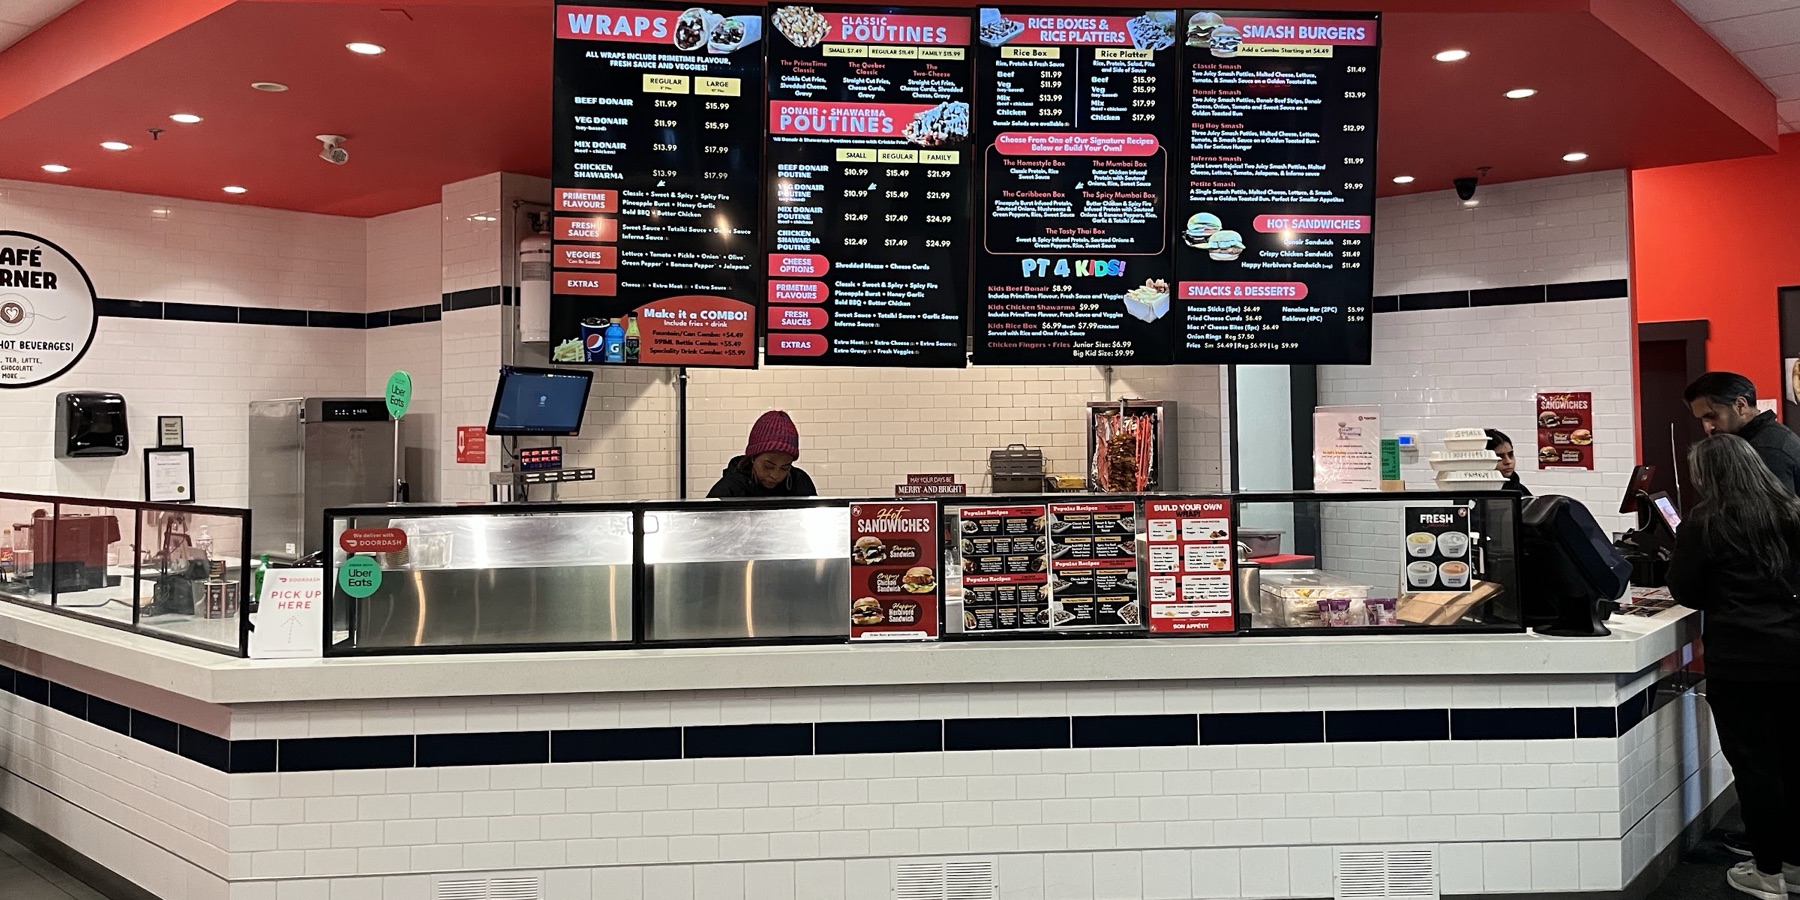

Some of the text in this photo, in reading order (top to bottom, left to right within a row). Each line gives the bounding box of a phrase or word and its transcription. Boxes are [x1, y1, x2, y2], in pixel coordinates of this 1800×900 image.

[842, 16, 887, 25] CLASSIC
[1028, 18, 1109, 30] RICE BOXES &
[568, 14, 668, 38] WRAPS
[842, 26, 946, 42] POUTINES
[1041, 32, 1125, 42] RICE PLATTERS
[1242, 25, 1365, 40] SMASH BURGERS
[657, 54, 695, 62] PRIMETIME
[1133, 76, 1156, 84] $15.99
[1039, 94, 1062, 102] $13.99
[599, 98, 633, 106] DONAIR
[655, 100, 677, 108] $11.99
[705, 102, 729, 110] $15.99
[781, 107, 885, 117] DONAIR SHAWARMA
[594, 117, 628, 125] DONAIR
[654, 119, 676, 127] $11.99
[705, 122, 729, 130] $15.99
[780, 116, 893, 133] POUTINES
[592, 142, 626, 150] DONAIR
[653, 144, 677, 152] $13.99
[704, 146, 728, 154] $17.99
[574, 163, 612, 171] CHICKEN
[574, 171, 623, 180] SHAWARMA
[704, 172, 728, 180] $17.99
[844, 168, 868, 176] $10.99
[927, 170, 950, 178] $21.99
[563, 193, 605, 201] PRIMETIME
[563, 201, 605, 209] FLAVOURS
[926, 215, 951, 223] $24.99
[1267, 220, 1360, 229] HOT SANDWICHES
[568, 229, 599, 237] SAUCES
[0, 246, 42, 267] AFÉ
[566, 251, 601, 259] VEGGIES
[1022, 259, 1126, 277] PT 4 KIDS!
[0, 269, 57, 290] RNER
[568, 280, 598, 288] EXTRAS
[1188, 286, 1296, 296] SNACKS & DESSERTS
[644, 309, 675, 319] Make
[678, 310, 686, 319] it
[700, 310, 747, 321] COMBO!
[392, 384, 405, 397] Uber
[390, 395, 404, 408] Eats
[1541, 401, 1588, 410] SANDWICHES
[877, 506, 910, 520] Hot
[1420, 514, 1453, 523] FRESH
[858, 519, 930, 532] SANDWICHES
[349, 569, 372, 577] Uber
[278, 601, 311, 609] HERE
